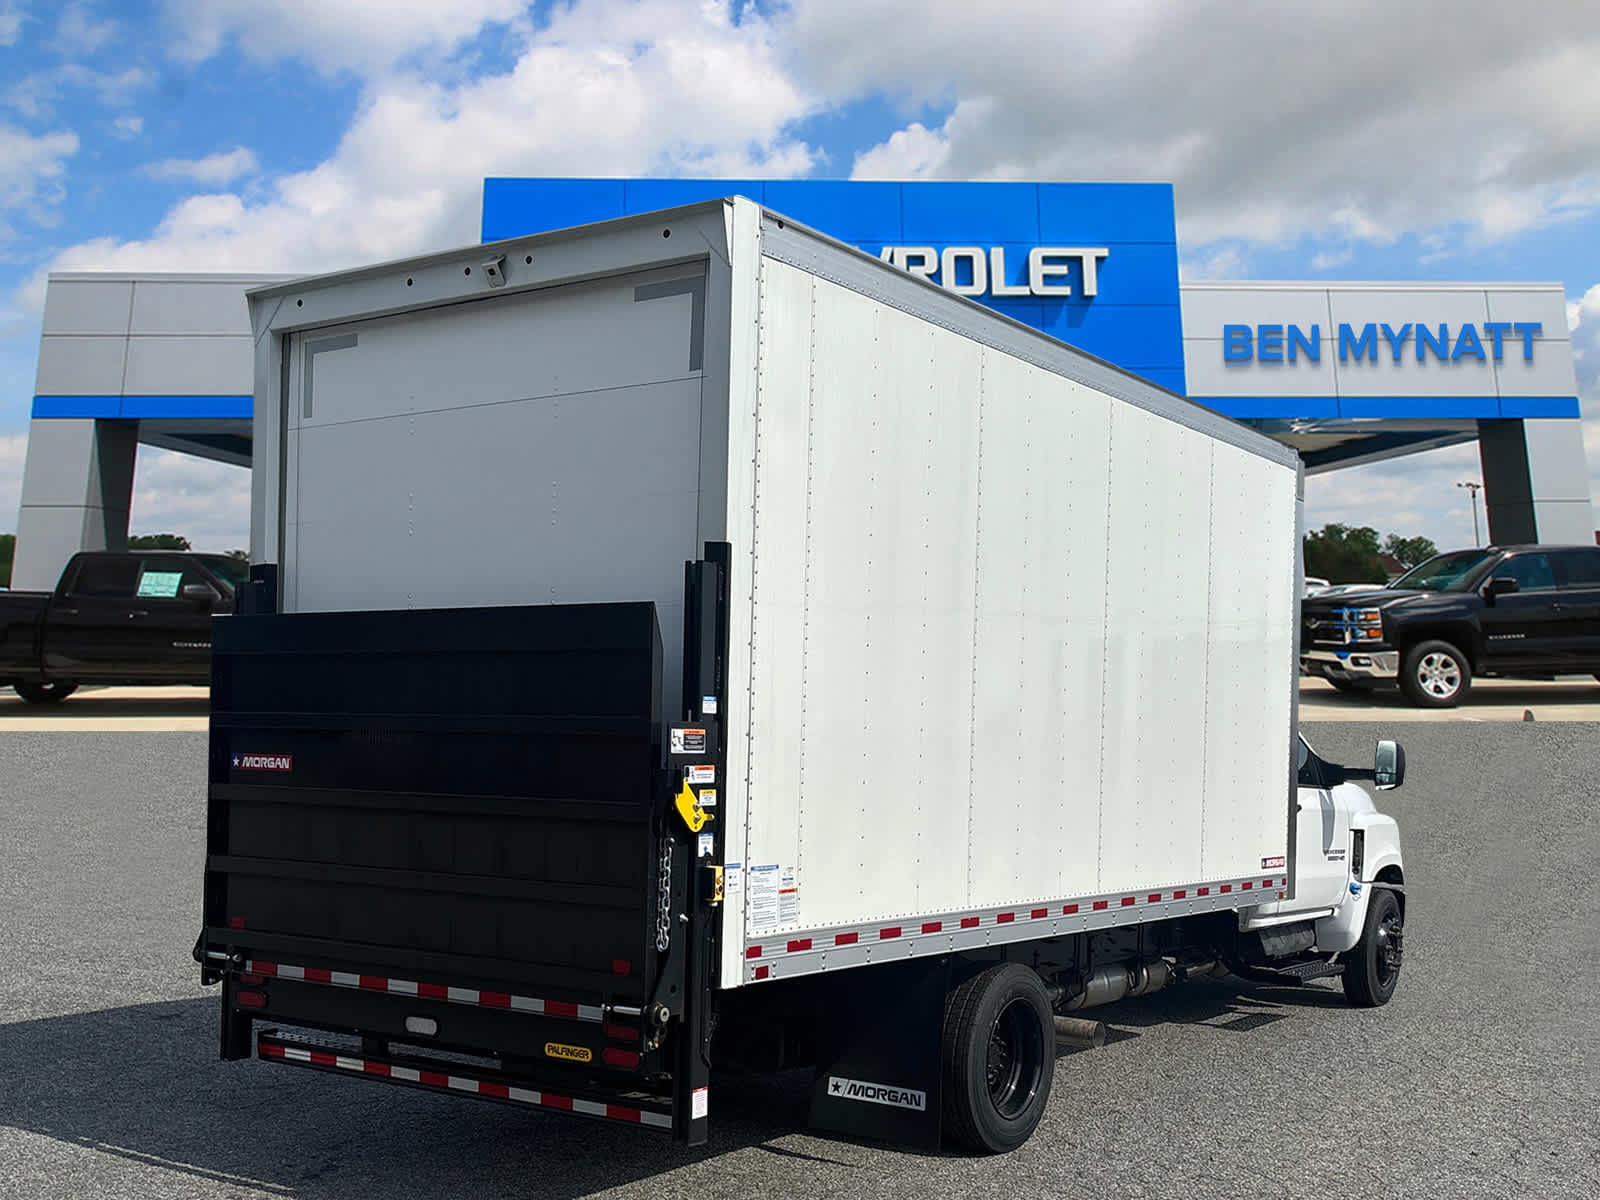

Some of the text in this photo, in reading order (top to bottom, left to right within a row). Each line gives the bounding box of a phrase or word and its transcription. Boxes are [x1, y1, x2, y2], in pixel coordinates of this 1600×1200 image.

[1224, 322, 1542, 362] BEN MYNATT
[242, 756, 291, 769] MORGAN
[547, 1045, 589, 1060] PALFINGER
[847, 1083, 922, 1107] MORGAN
